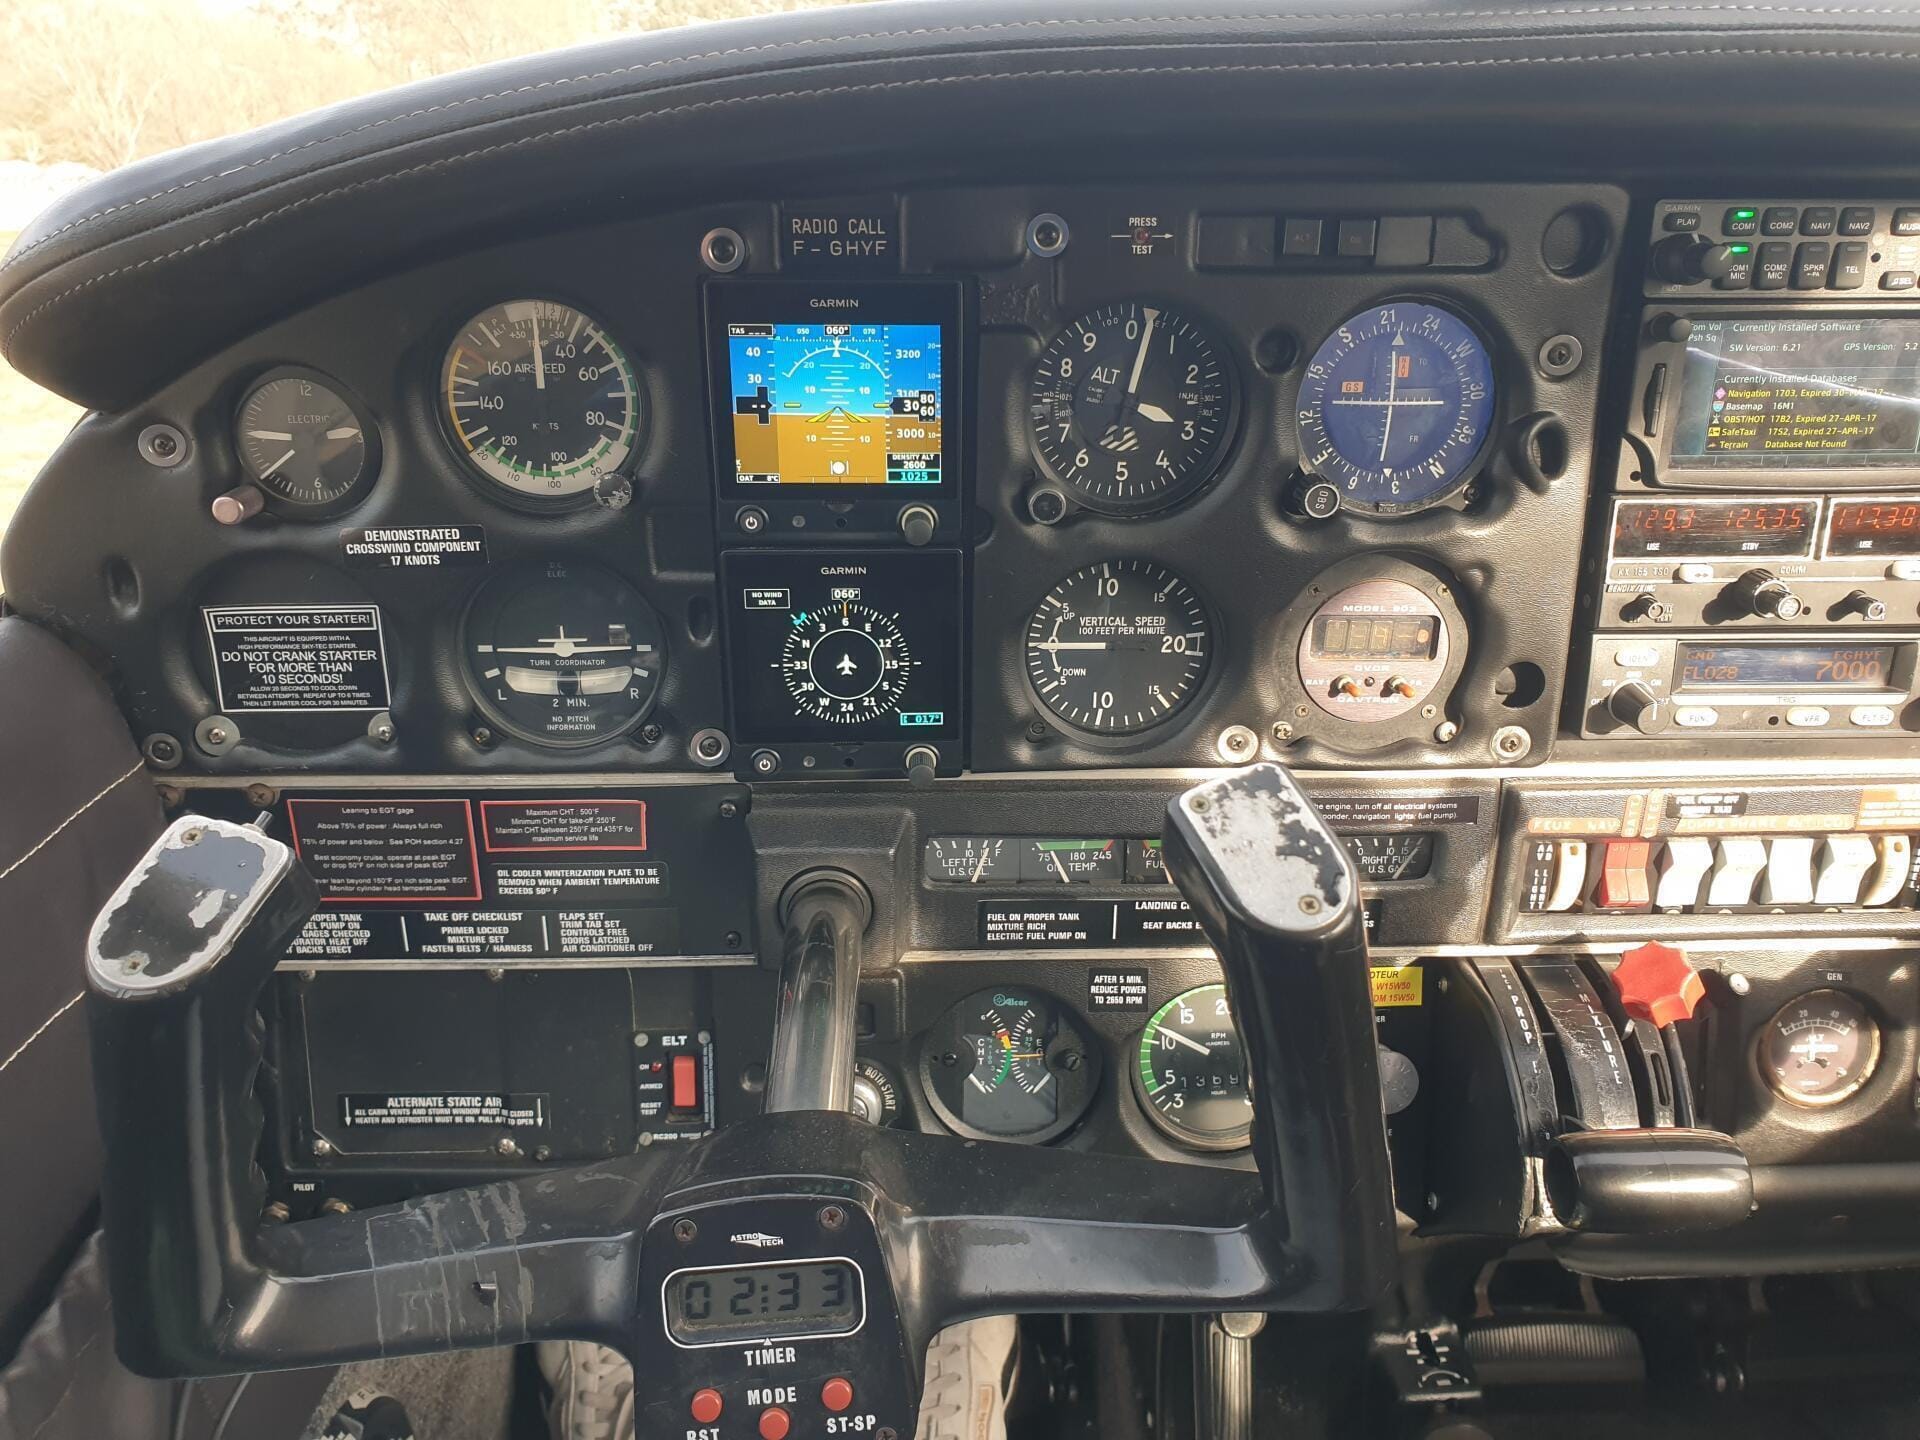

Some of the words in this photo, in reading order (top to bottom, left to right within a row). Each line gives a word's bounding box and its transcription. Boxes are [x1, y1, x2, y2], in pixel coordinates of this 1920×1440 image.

[1129, 217, 1157, 226] PRESS
[1677, 218, 1696, 226] PLAY
[1732, 222, 1755, 230] COM1
[1770, 222, 1794, 230] COM2
[1811, 222, 1831, 230] NAV1
[1849, 222, 1870, 230] NAV2
[792, 219, 838, 235] RADIO
[848, 219, 886, 235] CALL
[1132, 245, 1153, 254] TEST
[1764, 264, 1787, 272] COM2
[1804, 264, 1824, 272] SPKR
[1846, 265, 1859, 274] TEL
[1768, 271, 1783, 280] MIC
[810, 299, 859, 308] GARMIN
[1380, 310, 1395, 324] 21
[1422, 315, 1440, 330] 24
[797, 327, 809, 335] 050
[863, 327, 876, 335] 070
[1733, 323, 1777, 333] Currently
[1779, 323, 1818, 331] Installed
[1820, 323, 1861, 331] Software
[555, 344, 575, 358] 40
[1747, 343, 1779, 351] Version:
[895, 350, 921, 359] 3200
[487, 361, 511, 375] 160
[1307, 364, 1323, 379] 15
[578, 367, 599, 381] 60
[1091, 366, 1120, 385] ALT
[300, 384, 312, 397] 12
[1470, 383, 1485, 400] 30
[1728, 389, 1771, 398] Navigation
[479, 396, 504, 410] 140
[1726, 402, 1763, 412] Basemap
[1773, 402, 1794, 410] 16M1
[287, 414, 330, 425] ELECTRIC
[586, 411, 605, 426] 80
[1300, 409, 1313, 426] 12
[1724, 415, 1765, 423] OBST/HOT
[1795, 414, 1827, 424] Expired
[1829, 414, 1877, 423] 27-APR-17
[896, 429, 925, 438] 3000
[1721, 428, 1756, 436] SafeTaxi
[502, 436, 517, 445] 120
[1720, 441, 1748, 449] Terrain
[1765, 440, 1802, 448] Database
[1805, 440, 1818, 448] Not
[1820, 440, 1847, 448] Found
[551, 452, 567, 461] 100
[903, 461, 926, 469] 2600
[900, 472, 928, 481] 1025
[365, 529, 460, 541] DEMONSTRATED
[346, 543, 411, 554] CROSSWIND
[414, 541, 480, 553] COMPONENT
[391, 555, 401, 566] 17
[405, 554, 440, 565] KNOTS
[820, 567, 867, 575] GARMIN
[1098, 579, 1119, 597] 10
[217, 616, 273, 625] PROTECT
[276, 616, 310, 625] YOUR
[313, 615, 370, 625] STARTER!
[1080, 617, 1127, 626] VERTICAL
[1135, 617, 1165, 626] SPEED
[1079, 627, 1093, 635] 100
[1095, 627, 1115, 635] FEET
[1118, 627, 1134, 635] PER
[1137, 627, 1165, 635] MINUTE
[1161, 636, 1186, 653] 20
[222, 652, 240, 661] DO
[244, 652, 270, 661] NOT
[273, 651, 317, 661] CRANK
[319, 651, 377, 660] STARTER
[249, 663, 275, 672] FOR
[278, 663, 316, 672] MORE
[318, 663, 352, 672] THAN
[794, 661, 808, 669] 33
[1815, 662, 1881, 680] 7000
[262, 675, 276, 684] 10
[278, 674, 343, 684] SECONDS!
[552, 699, 559, 707] 2
[567, 699, 591, 707] MIN.
[1093, 692, 1114, 709] 10
[1428, 803, 1458, 811] systems
[942, 858, 968, 866] LEFT
[1362, 856, 1388, 864] RIGHT
[1068, 863, 1099, 871] TEMP.
[512, 869, 542, 877] COOLER
[544, 869, 605, 877] WINTERIZATION
[608, 868, 632, 876] PLATE
[564, 878, 602, 886] AMBIENT
[604, 877, 660, 885] TEMPERATURE
[1135, 901, 1177, 909] LANDING
[424, 913, 448, 921] TAKE
[452, 913, 469, 921] OFF
[472, 913, 523, 921] CHECKLIST
[1024, 913, 1055, 921] PROPER
[1127, 975, 1143, 983] MIN.
[1091, 986, 1118, 994] REDUCE
[1126, 996, 1142, 1004] RPM
[1511, 995, 1532, 1044] PROP
[662, 1036, 687, 1046] ELT
[387, 1098, 444, 1107] ALTERNATE
[447, 1097, 481, 1107] STATIC
[484, 1097, 502, 1107] AIR
[293, 1183, 315, 1191] PILOT
[731, 1233, 758, 1242] ASTRO
[761, 1238, 783, 1246] TECH
[744, 1348, 796, 1366] TIMER
[747, 1387, 797, 1405] MODE
[827, 1415, 876, 1433] ST-SP
